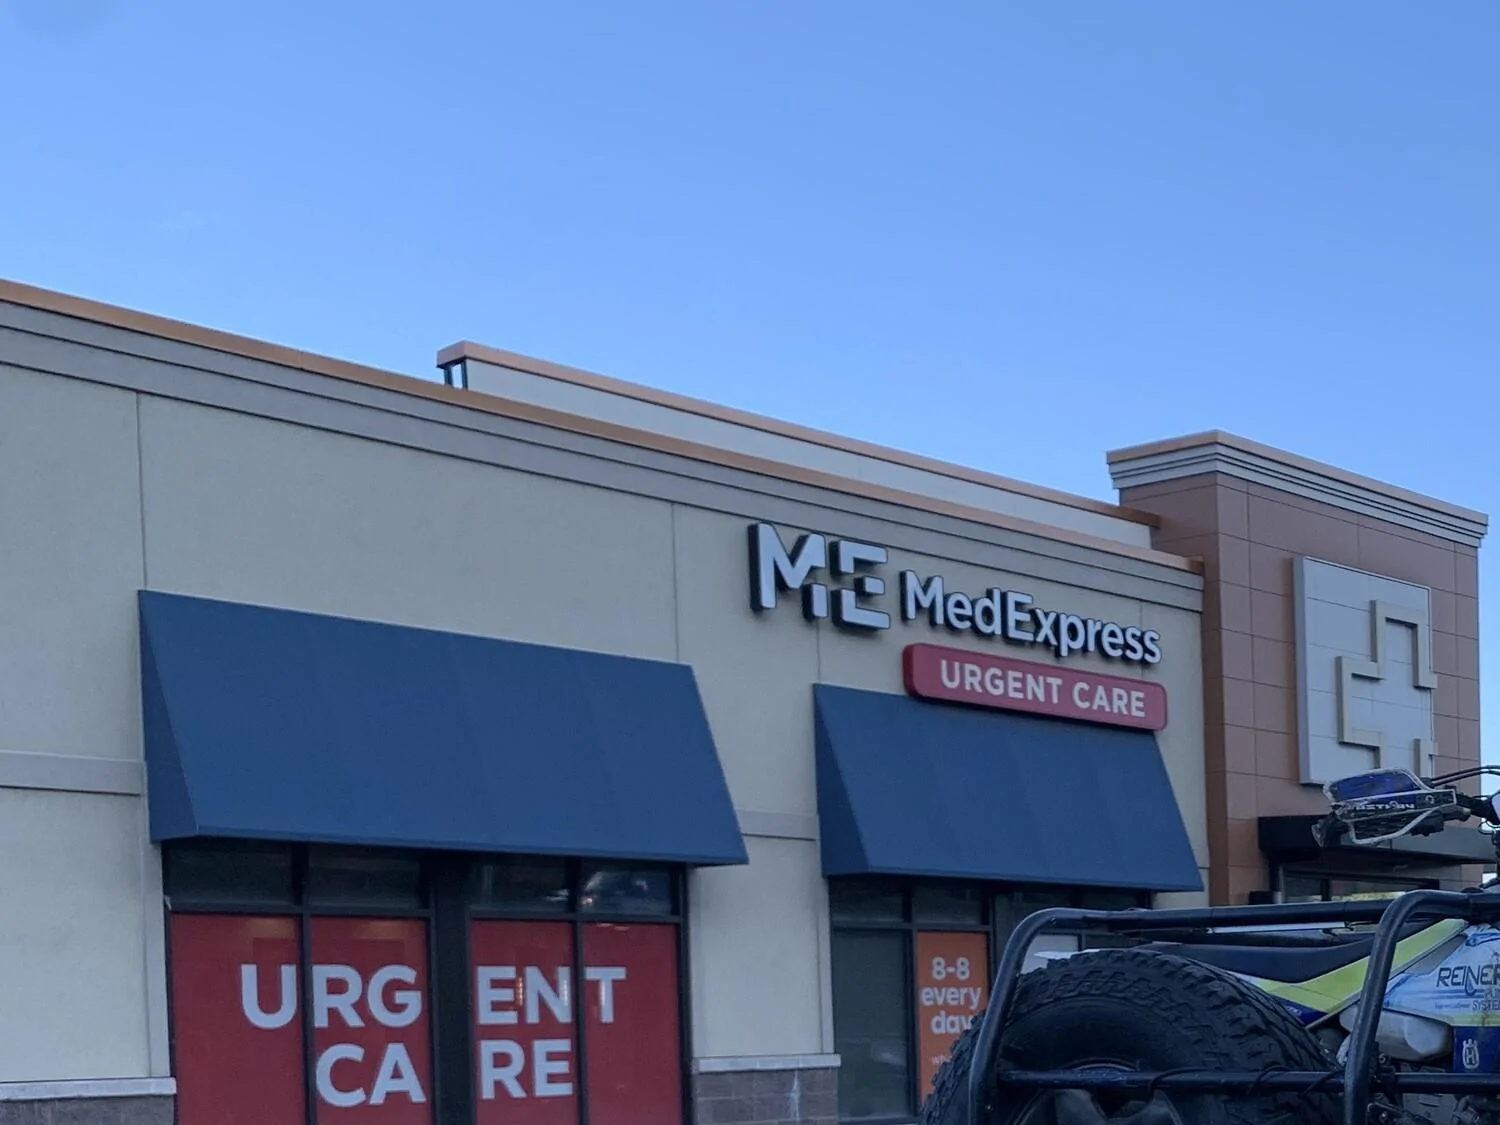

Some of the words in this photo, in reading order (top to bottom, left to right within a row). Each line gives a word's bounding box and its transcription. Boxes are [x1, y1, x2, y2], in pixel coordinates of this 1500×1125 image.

[901, 569, 1163, 665] MedExpress
[940, 659, 1062, 704] URGENT
[1072, 681, 1146, 718] CARE
[240, 963, 627, 1029] URGENT
[920, 986, 982, 1010] every
[932, 956, 970, 981] 8-8
[315, 1037, 574, 1107] CARE
